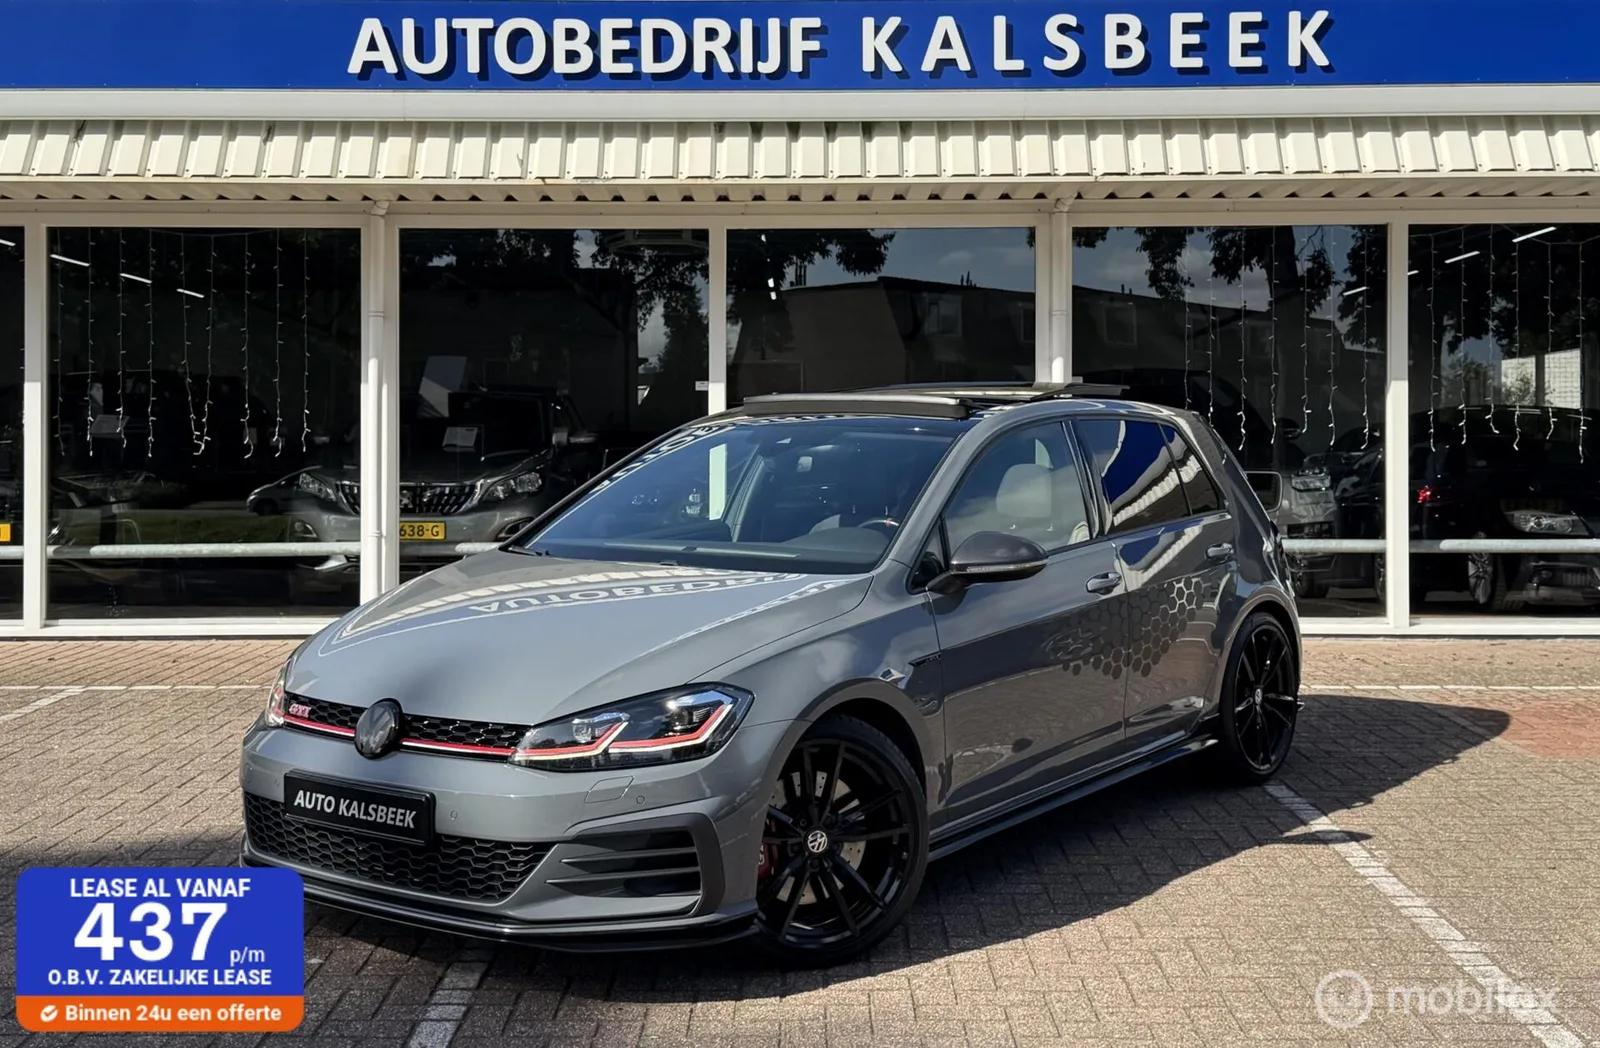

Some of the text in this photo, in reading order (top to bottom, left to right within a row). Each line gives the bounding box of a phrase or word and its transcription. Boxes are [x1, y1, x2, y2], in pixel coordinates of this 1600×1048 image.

[347, 9, 1331, 76] AUTOBEDRIJF KALSBEEK
[399, 524, 440, 537] 638-G
[288, 702, 312, 718] GTI
[294, 789, 418, 829] AUTO KALSBEEK
